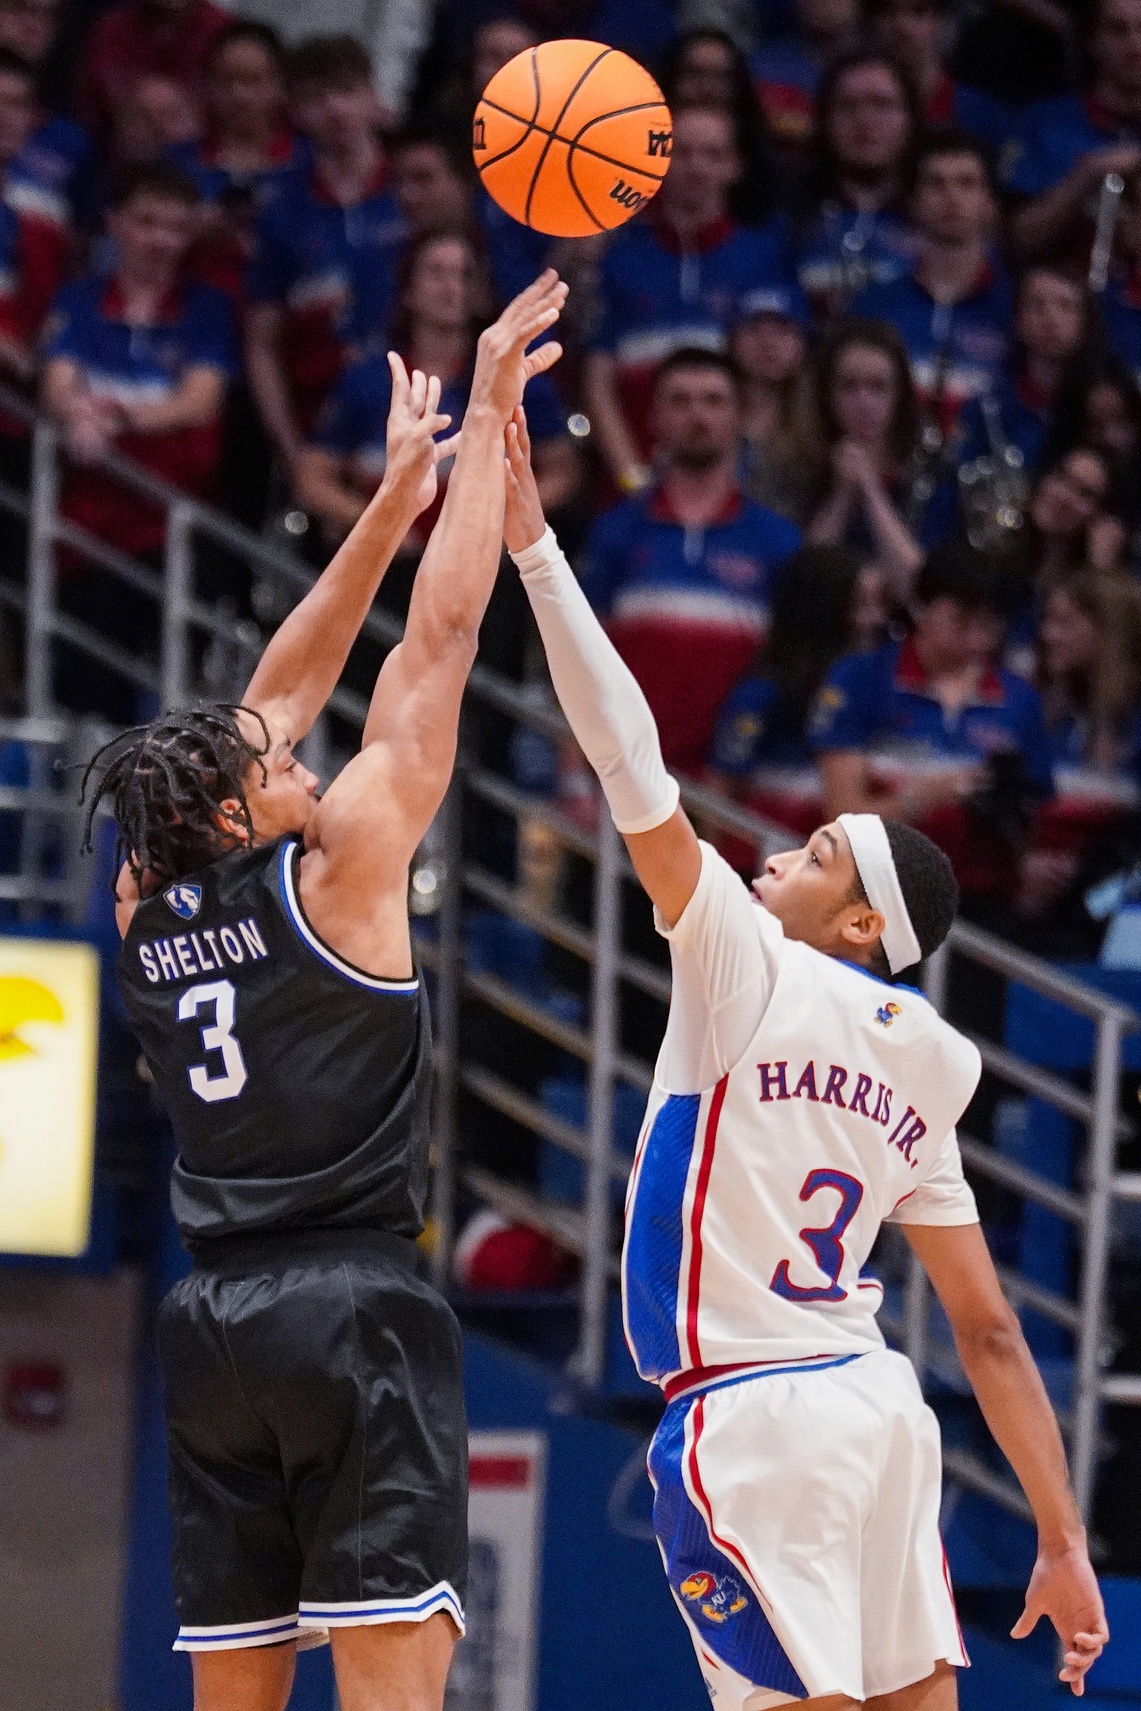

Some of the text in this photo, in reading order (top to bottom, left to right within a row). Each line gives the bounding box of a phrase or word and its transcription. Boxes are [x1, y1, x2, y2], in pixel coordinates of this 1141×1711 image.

[139, 918, 267, 983] SHELTON
[176, 979, 248, 1104] 3
[757, 1061, 927, 1169] HARRIS JR.
[769, 1168, 864, 1302] 3
